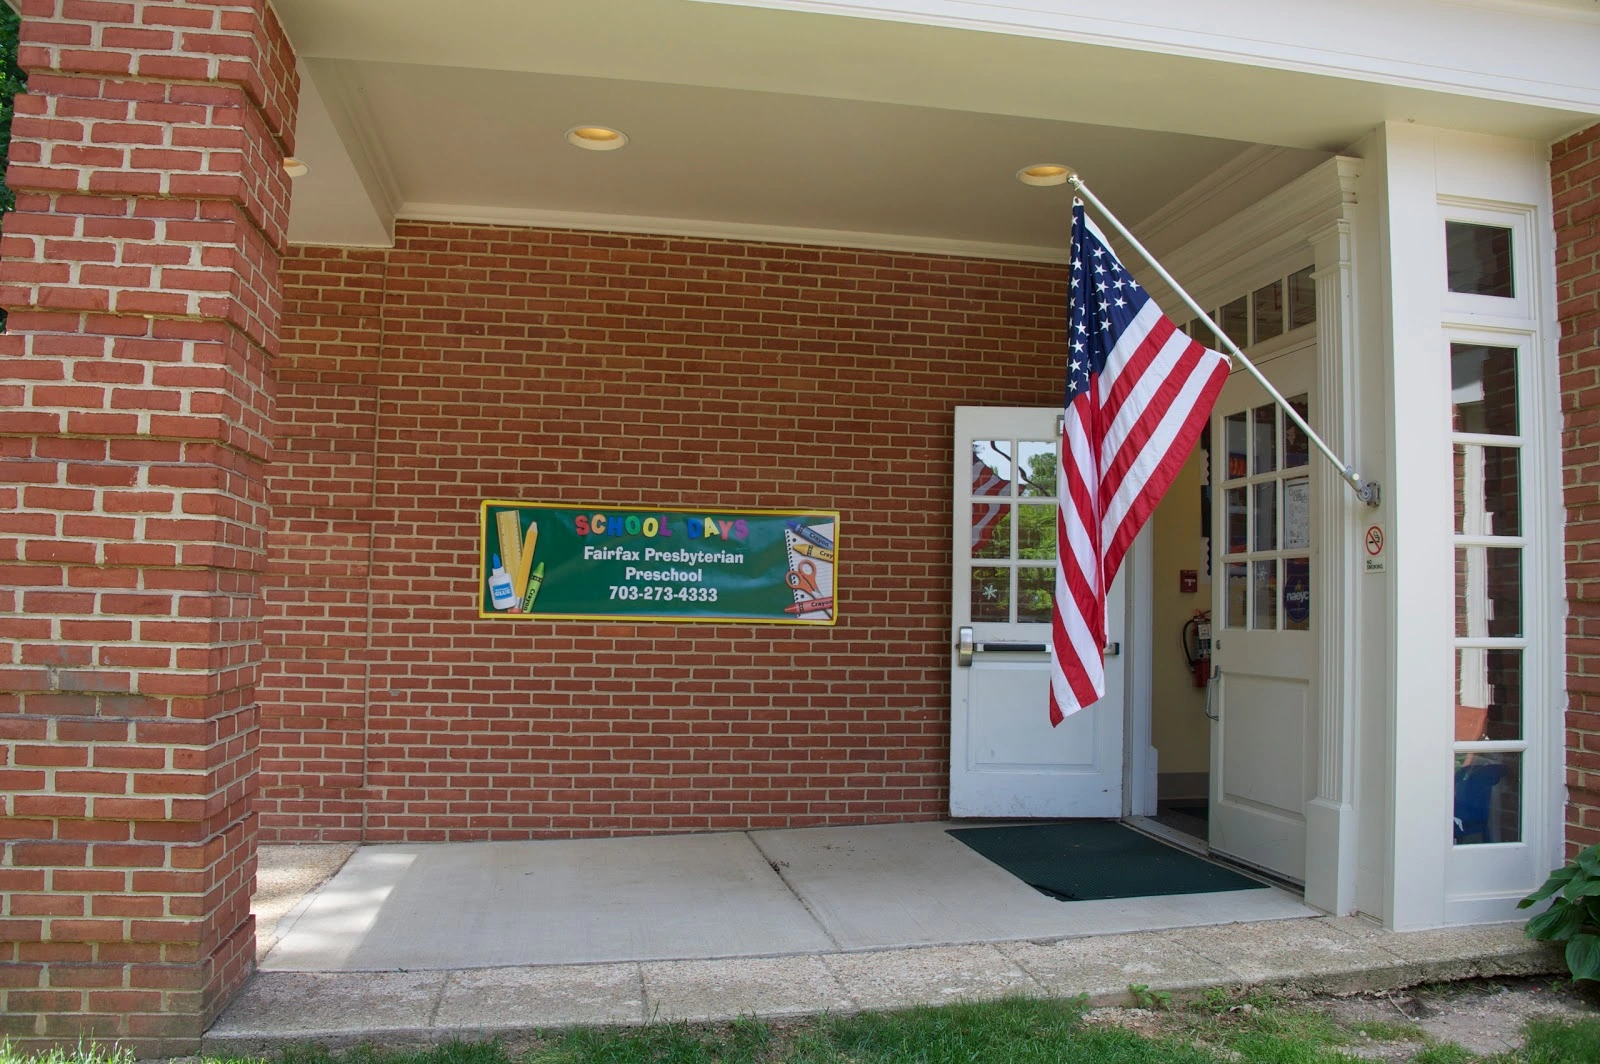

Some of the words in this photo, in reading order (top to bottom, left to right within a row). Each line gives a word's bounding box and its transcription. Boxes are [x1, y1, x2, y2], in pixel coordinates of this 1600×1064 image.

[575, 514, 673, 538] SCHOOL
[687, 517, 749, 541] DAYS
[809, 532, 830, 548] Crayon
[584, 546, 640, 561] Fairfax
[644, 548, 744, 566] Presbyterian
[625, 567, 703, 582] Preschool
[523, 588, 536, 611] Crayon
[609, 586, 718, 602] 703-273-4333
